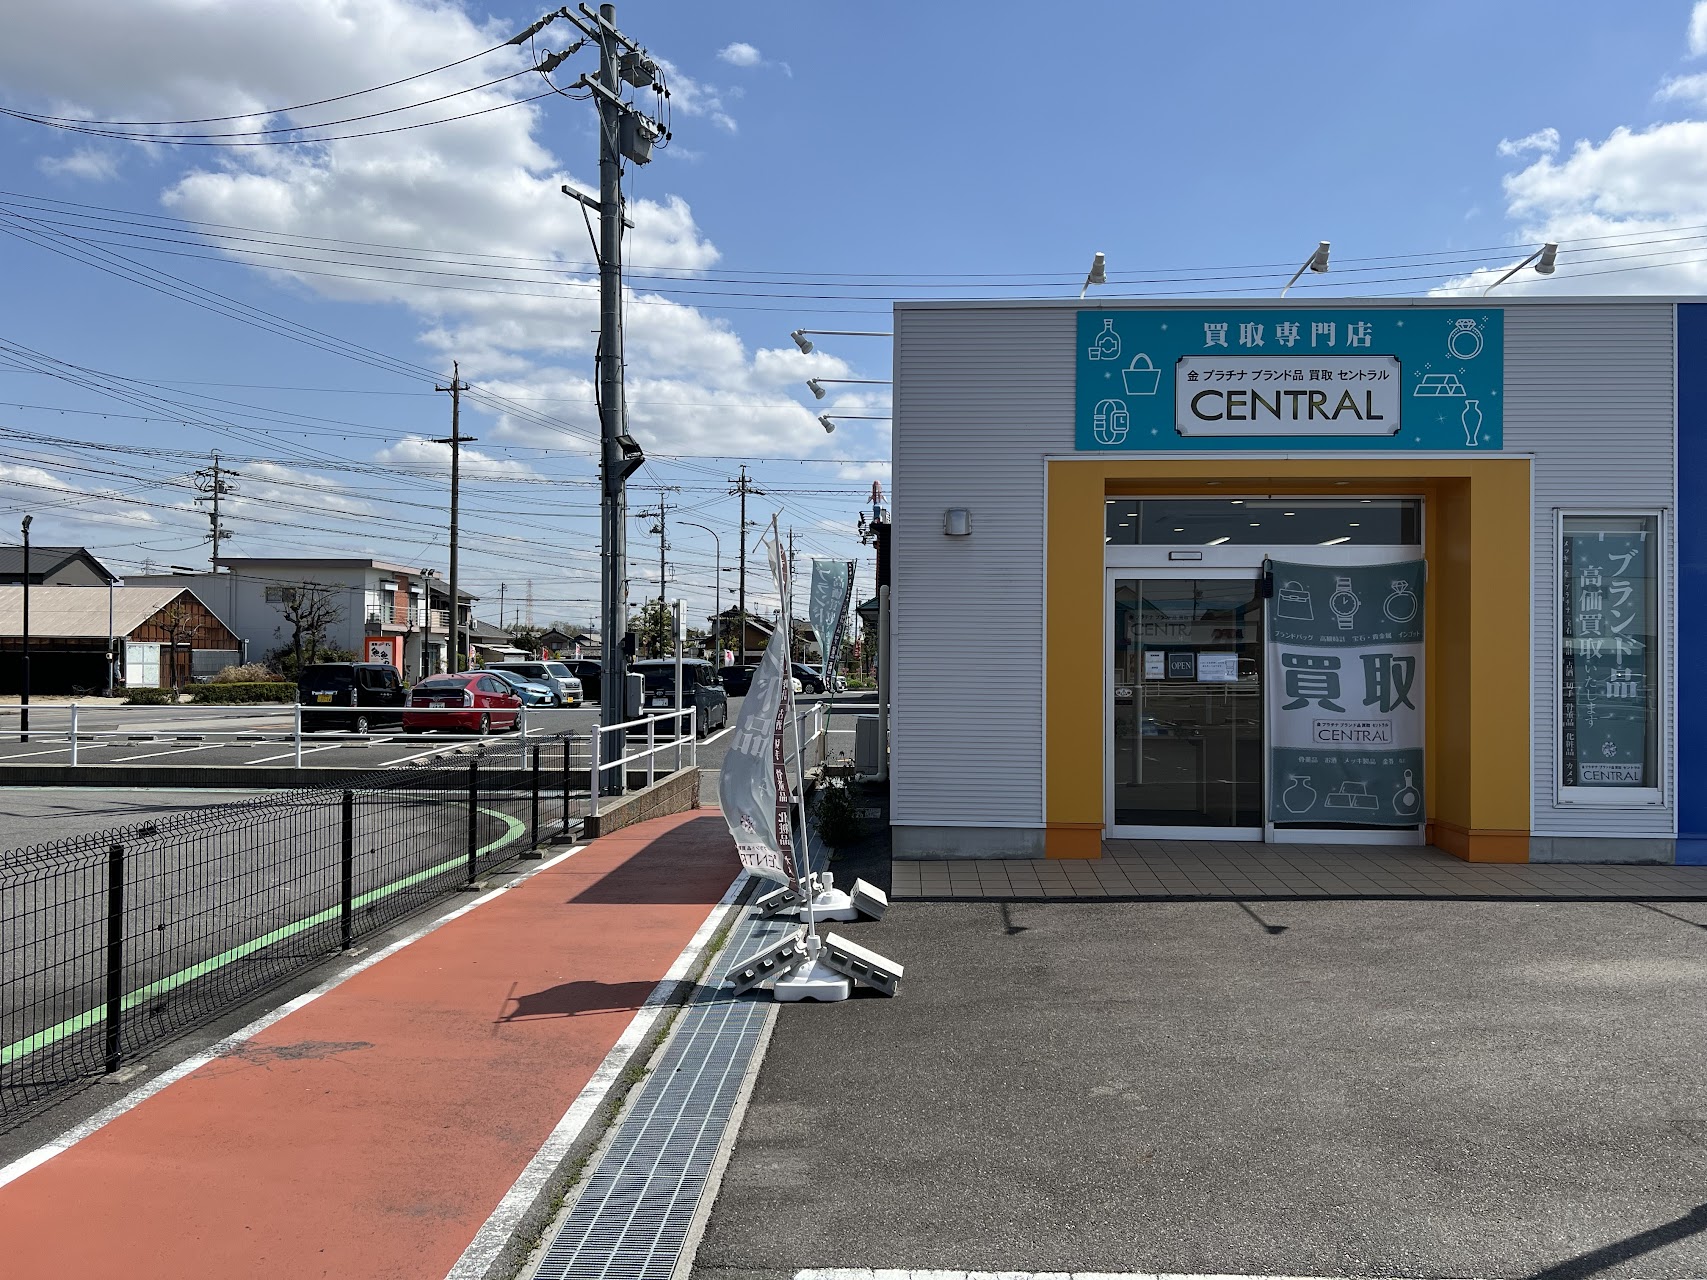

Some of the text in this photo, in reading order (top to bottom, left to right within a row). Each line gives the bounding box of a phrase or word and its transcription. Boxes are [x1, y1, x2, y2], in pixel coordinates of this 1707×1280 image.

[1203, 322, 1373, 348] 買取専門店
[1188, 370, 1390, 381] 金 プラチナ ブランド品 買取 セントラル
[1190, 388, 1384, 420] CENTRAL
[1606, 548, 1638, 698] ブランド品
[1171, 662, 1192, 670] OPEN
[1282, 652, 1416, 713] 買取
[1318, 730, 1388, 742] CENTRAL
[1566, 732, 1574, 756] 化粧品
[1566, 762, 1574, 785] カメラ
[1584, 770, 1639, 781] CENTRAL
